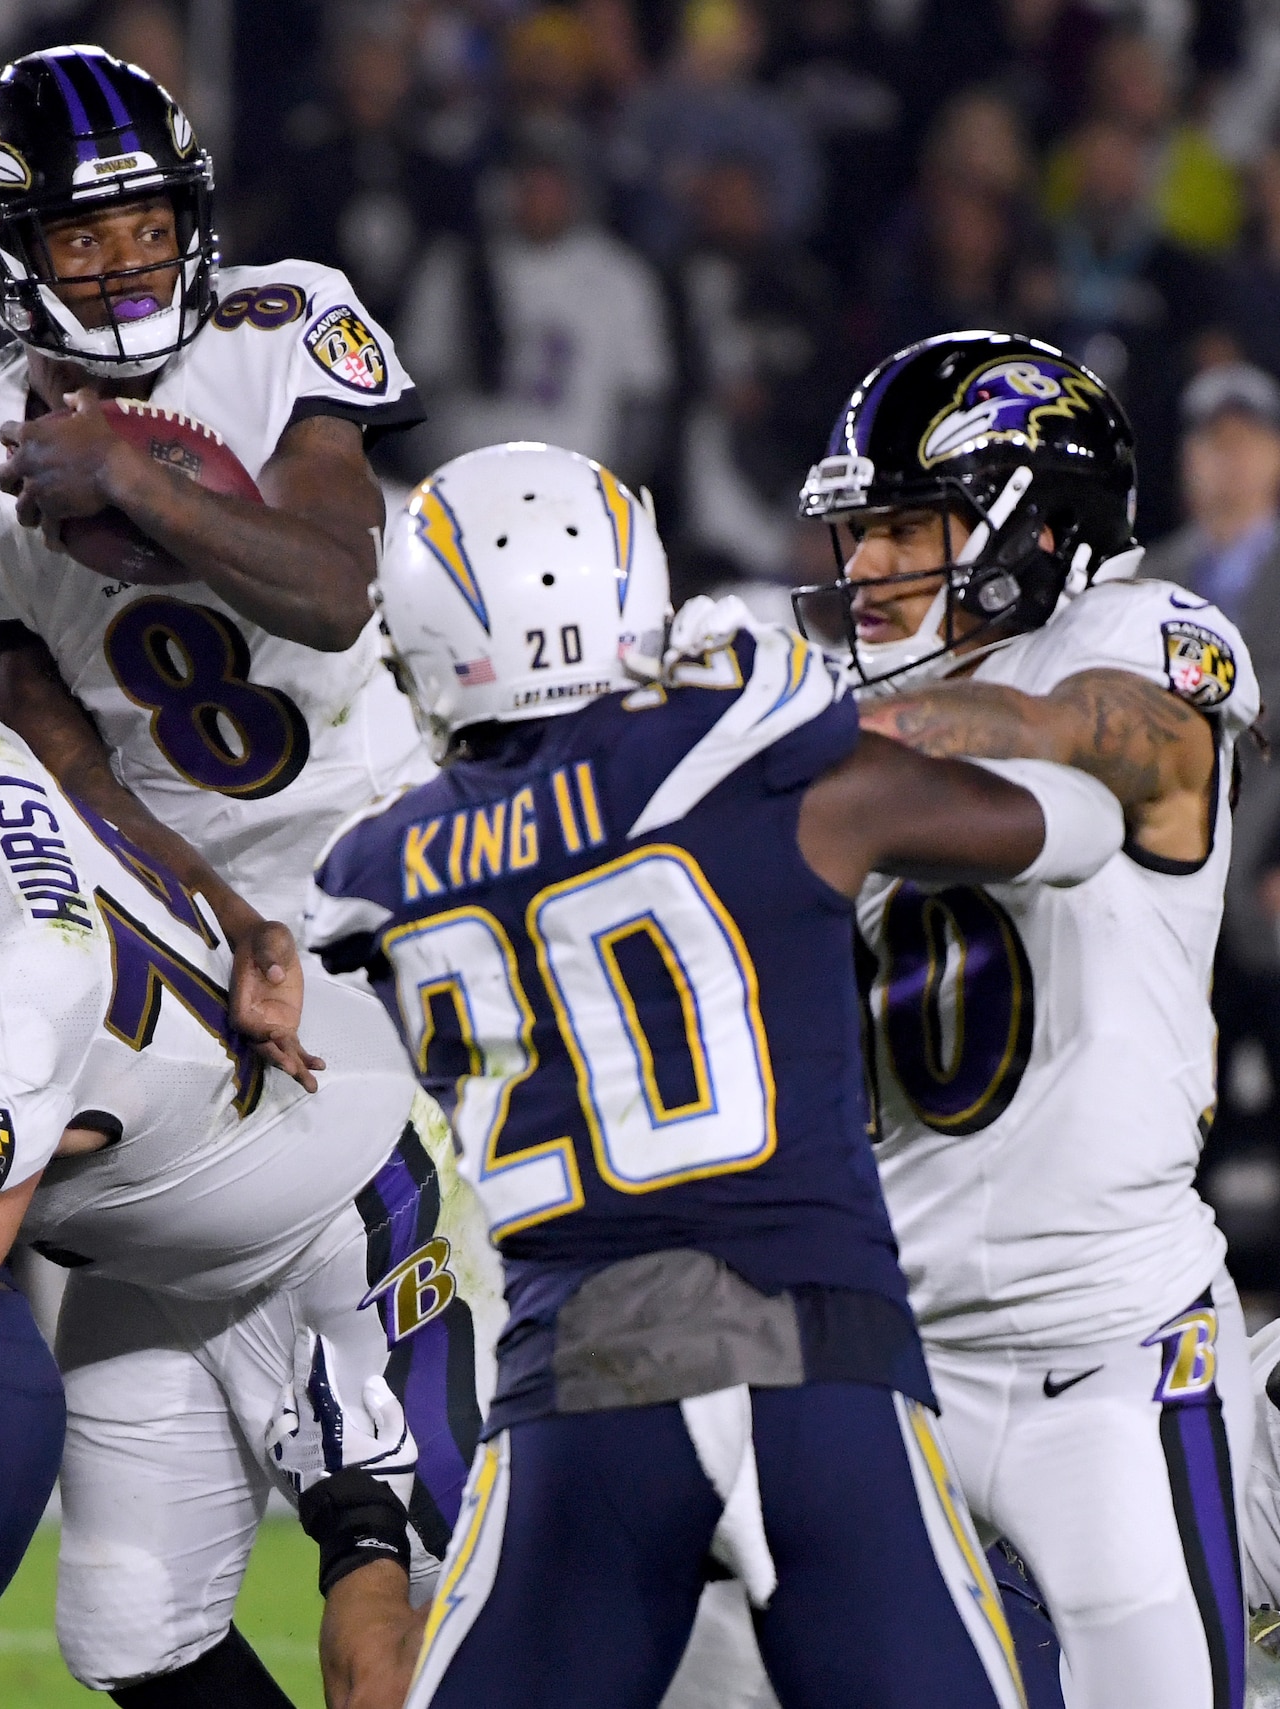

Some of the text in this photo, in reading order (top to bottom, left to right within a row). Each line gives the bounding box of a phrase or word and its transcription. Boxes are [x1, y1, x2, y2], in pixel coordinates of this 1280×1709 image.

[211, 283, 307, 332] 8
[307, 307, 351, 345] RAVENS
[526, 624, 583, 670] 20
[103, 594, 310, 800] 8
[403, 760, 607, 903] KING II
[382, 842, 778, 1248] 20
